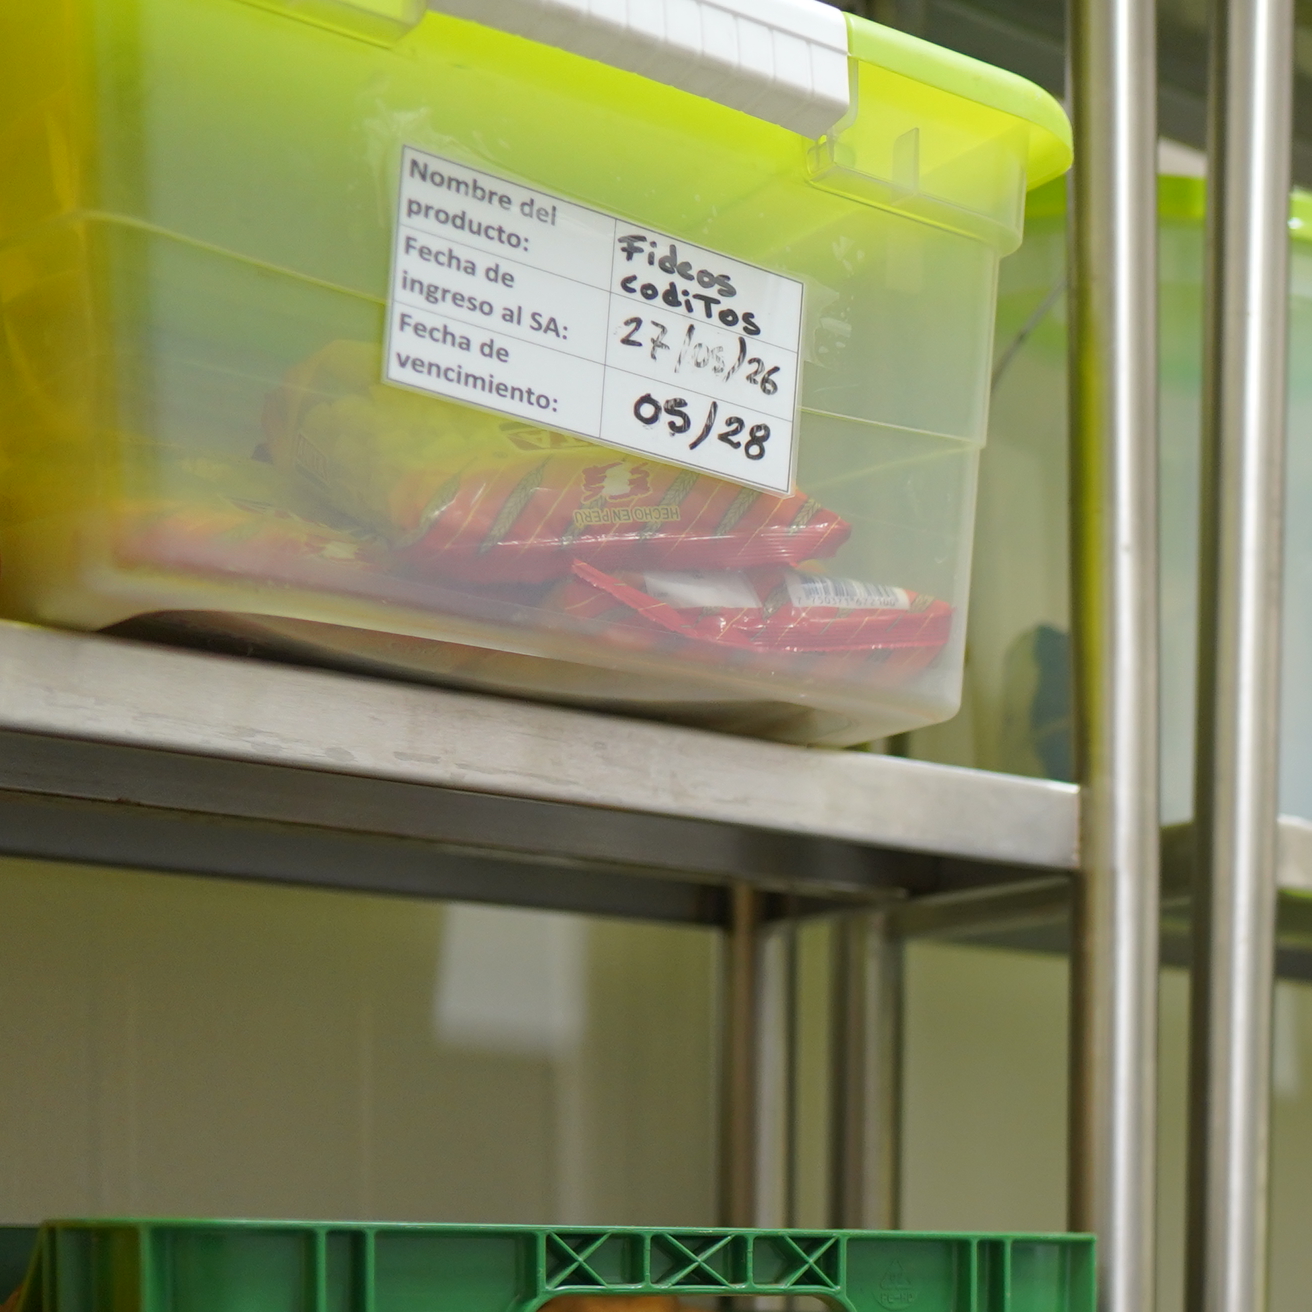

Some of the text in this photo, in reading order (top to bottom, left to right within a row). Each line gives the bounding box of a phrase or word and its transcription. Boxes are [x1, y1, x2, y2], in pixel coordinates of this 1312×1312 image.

[409, 158, 557, 226] Nombre del
[406, 198, 529, 252] producto:
[404, 235, 515, 288] Fecha de
[401, 270, 568, 340] ingreso al SA:
[399, 313, 510, 363] Fecha de
[396, 352, 558, 413] vencimiento:
[633, 393, 771, 461] 05/28
[575, 506, 679, 527] HECHO EN PERÚ
